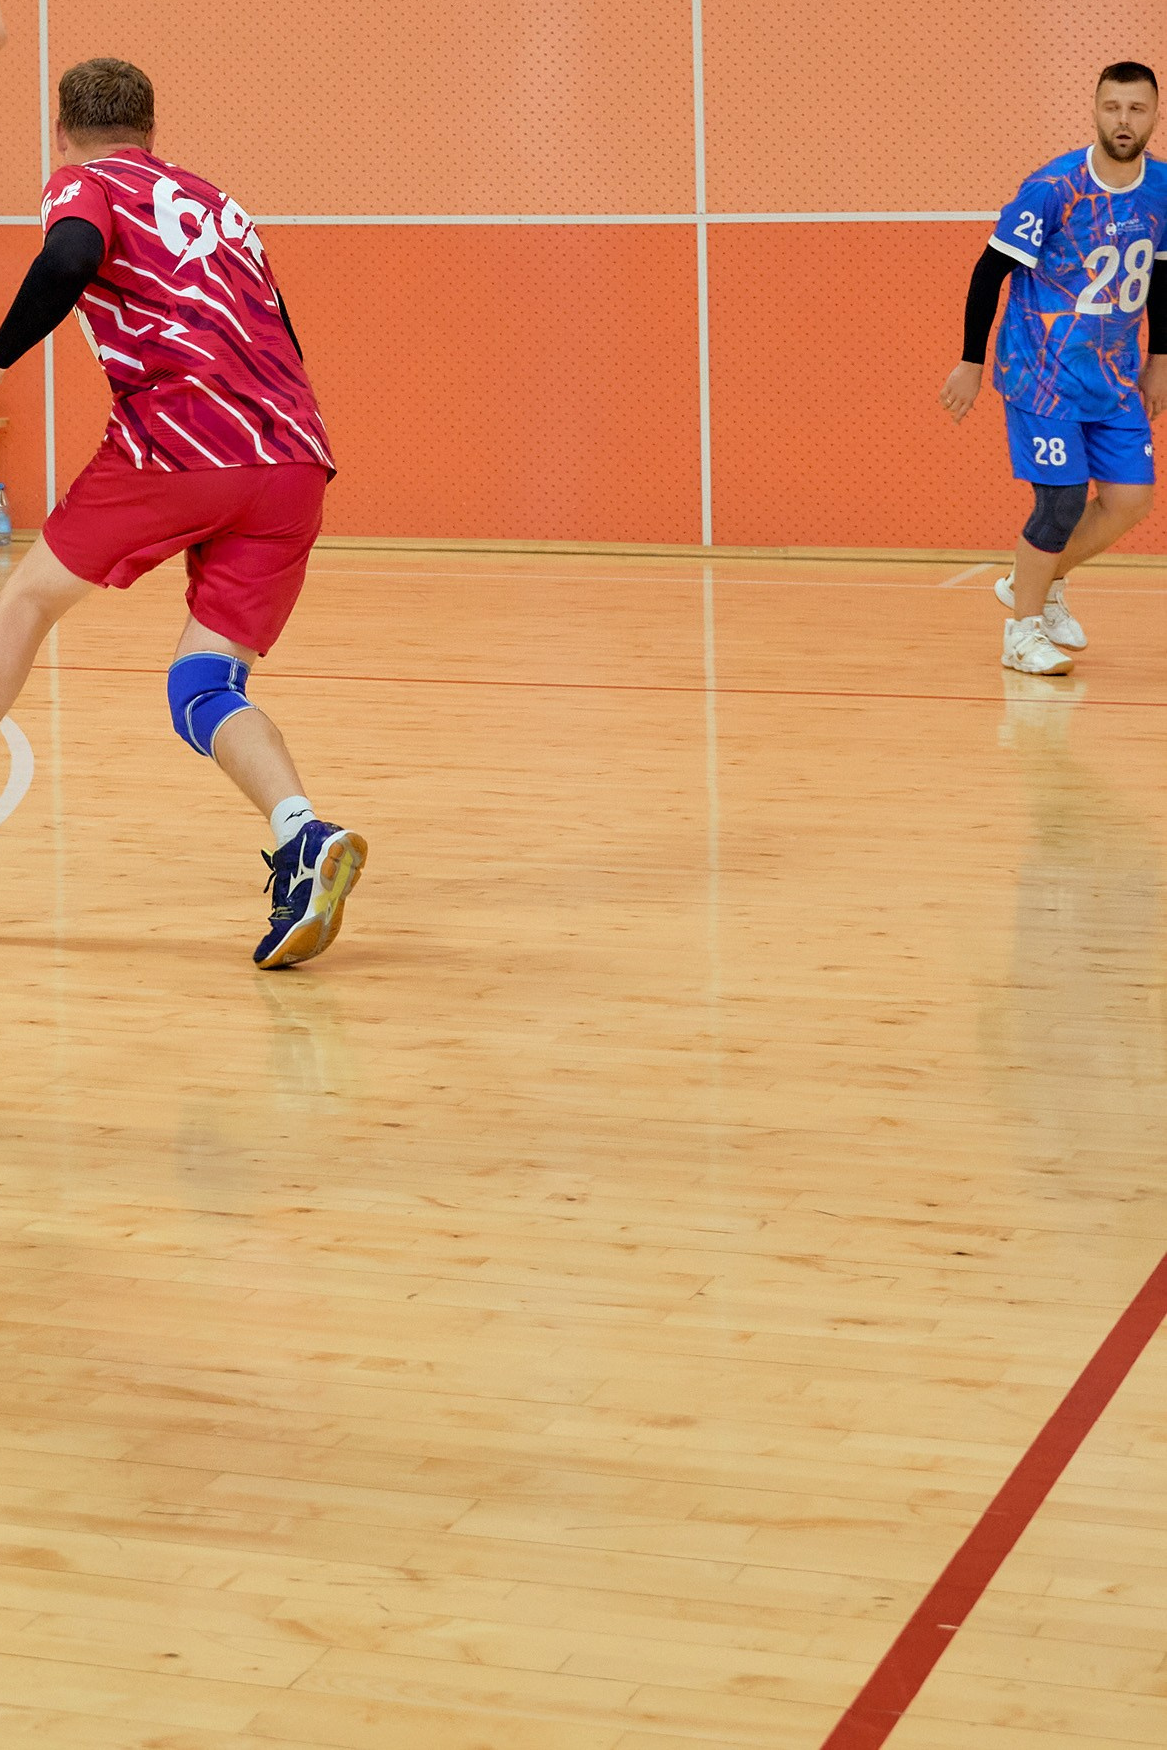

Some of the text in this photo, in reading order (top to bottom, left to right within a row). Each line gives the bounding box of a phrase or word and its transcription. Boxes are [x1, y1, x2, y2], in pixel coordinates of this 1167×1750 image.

[1013, 210, 1043, 247] 28
[1074, 238, 1153, 315] 28
[1032, 436, 1067, 466] 28
